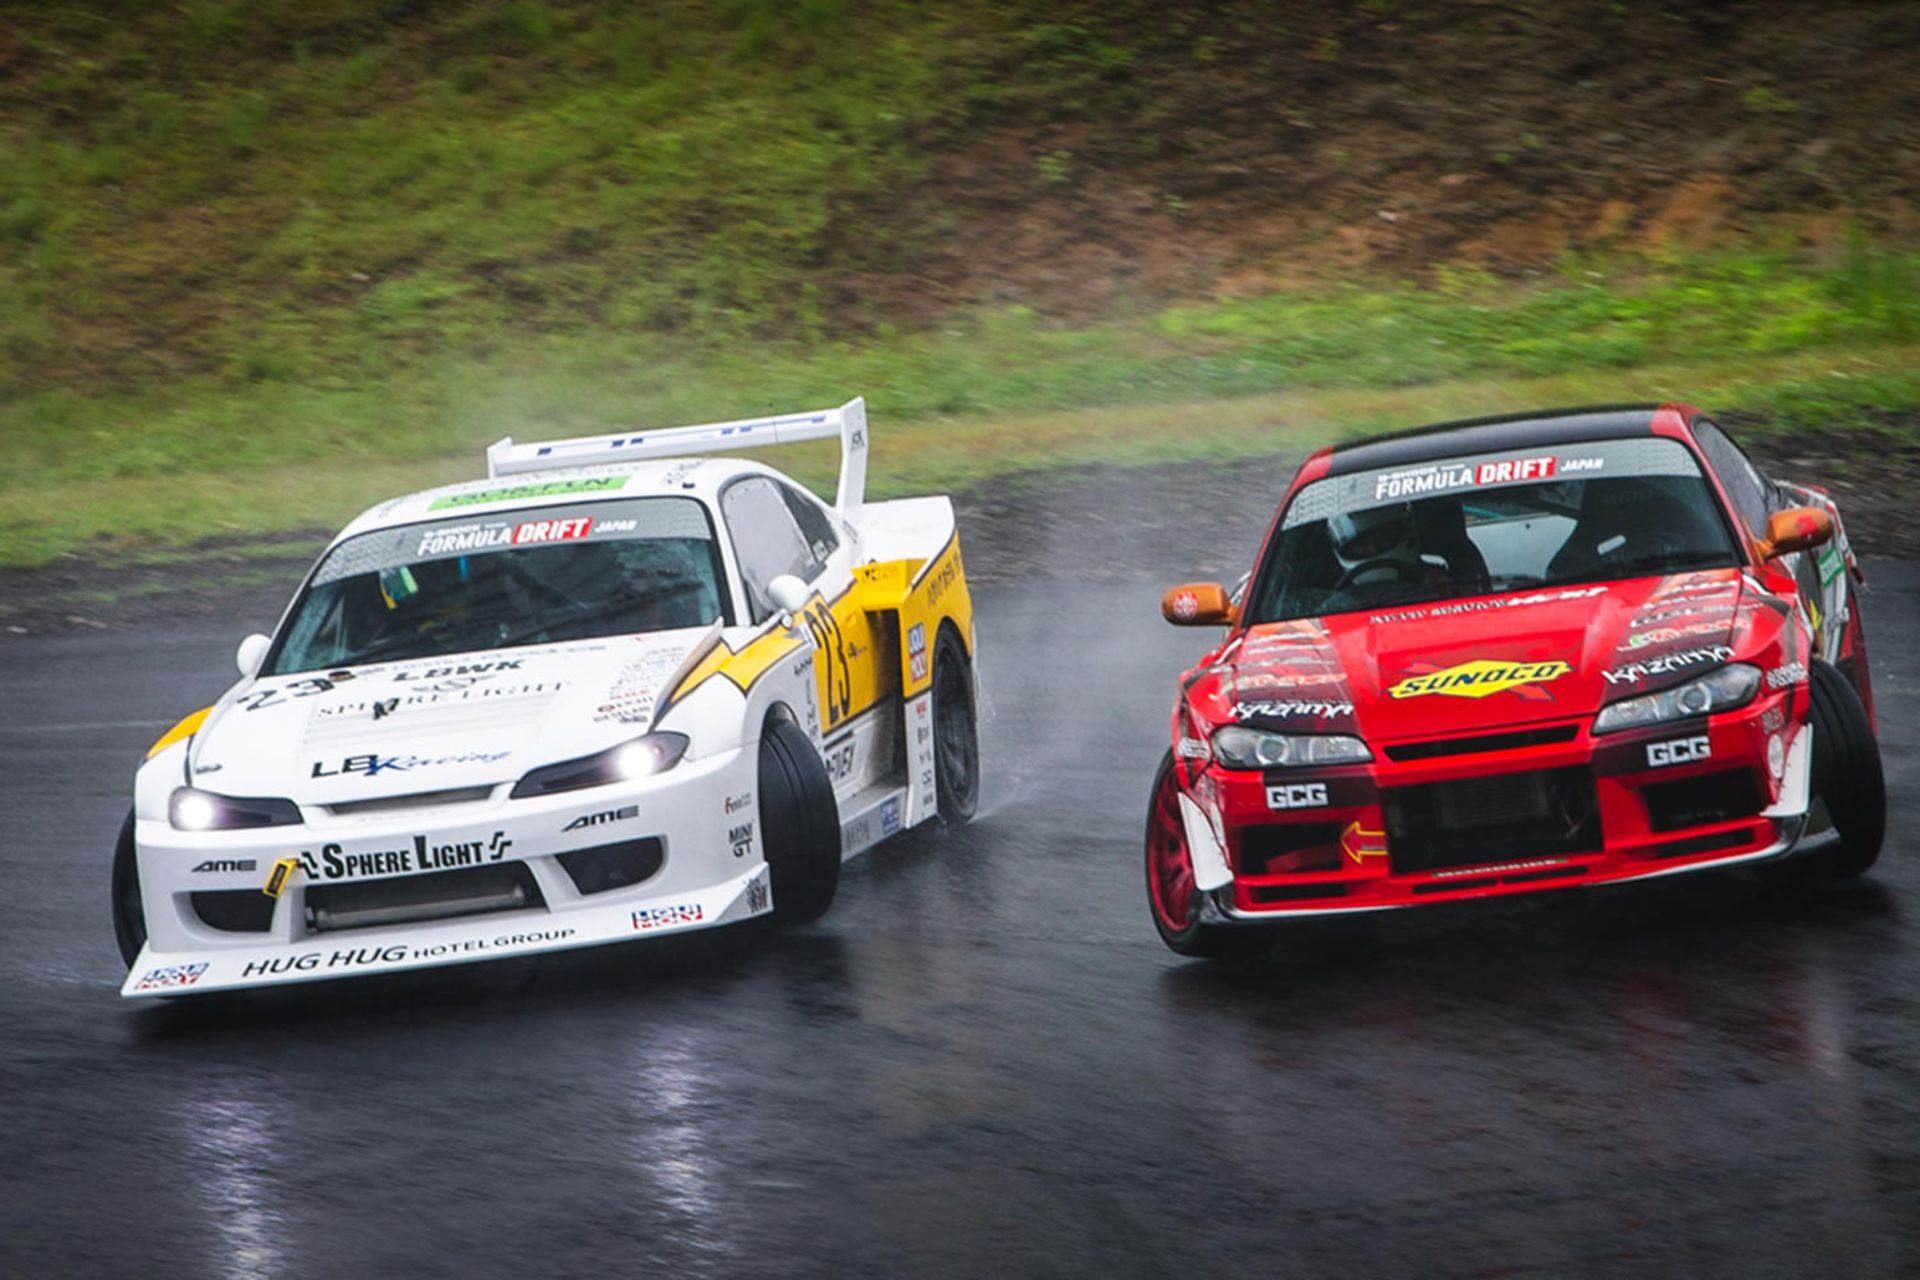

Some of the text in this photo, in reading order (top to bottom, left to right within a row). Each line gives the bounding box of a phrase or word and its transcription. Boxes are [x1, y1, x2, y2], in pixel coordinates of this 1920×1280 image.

[1376, 458, 1604, 500] FORMULA DRIFT JAPAN
[417, 527, 512, 556] FORMULA
[515, 518, 589, 544] DRIFT
[594, 520, 638, 533] JAPAN
[237, 678, 335, 711] 23
[1399, 664, 1558, 695] SUNOCO
[1646, 736, 1711, 767] GCG
[1265, 783, 1328, 809] GCG
[562, 805, 639, 832] AME
[729, 822, 753, 844] MINI
[322, 843, 412, 879] SPHERE
[413, 834, 484, 870] LIGHT
[733, 839, 753, 858] GT
[190, 859, 257, 873] AME
[241, 952, 321, 978] HUG
[327, 945, 409, 967] HUG
